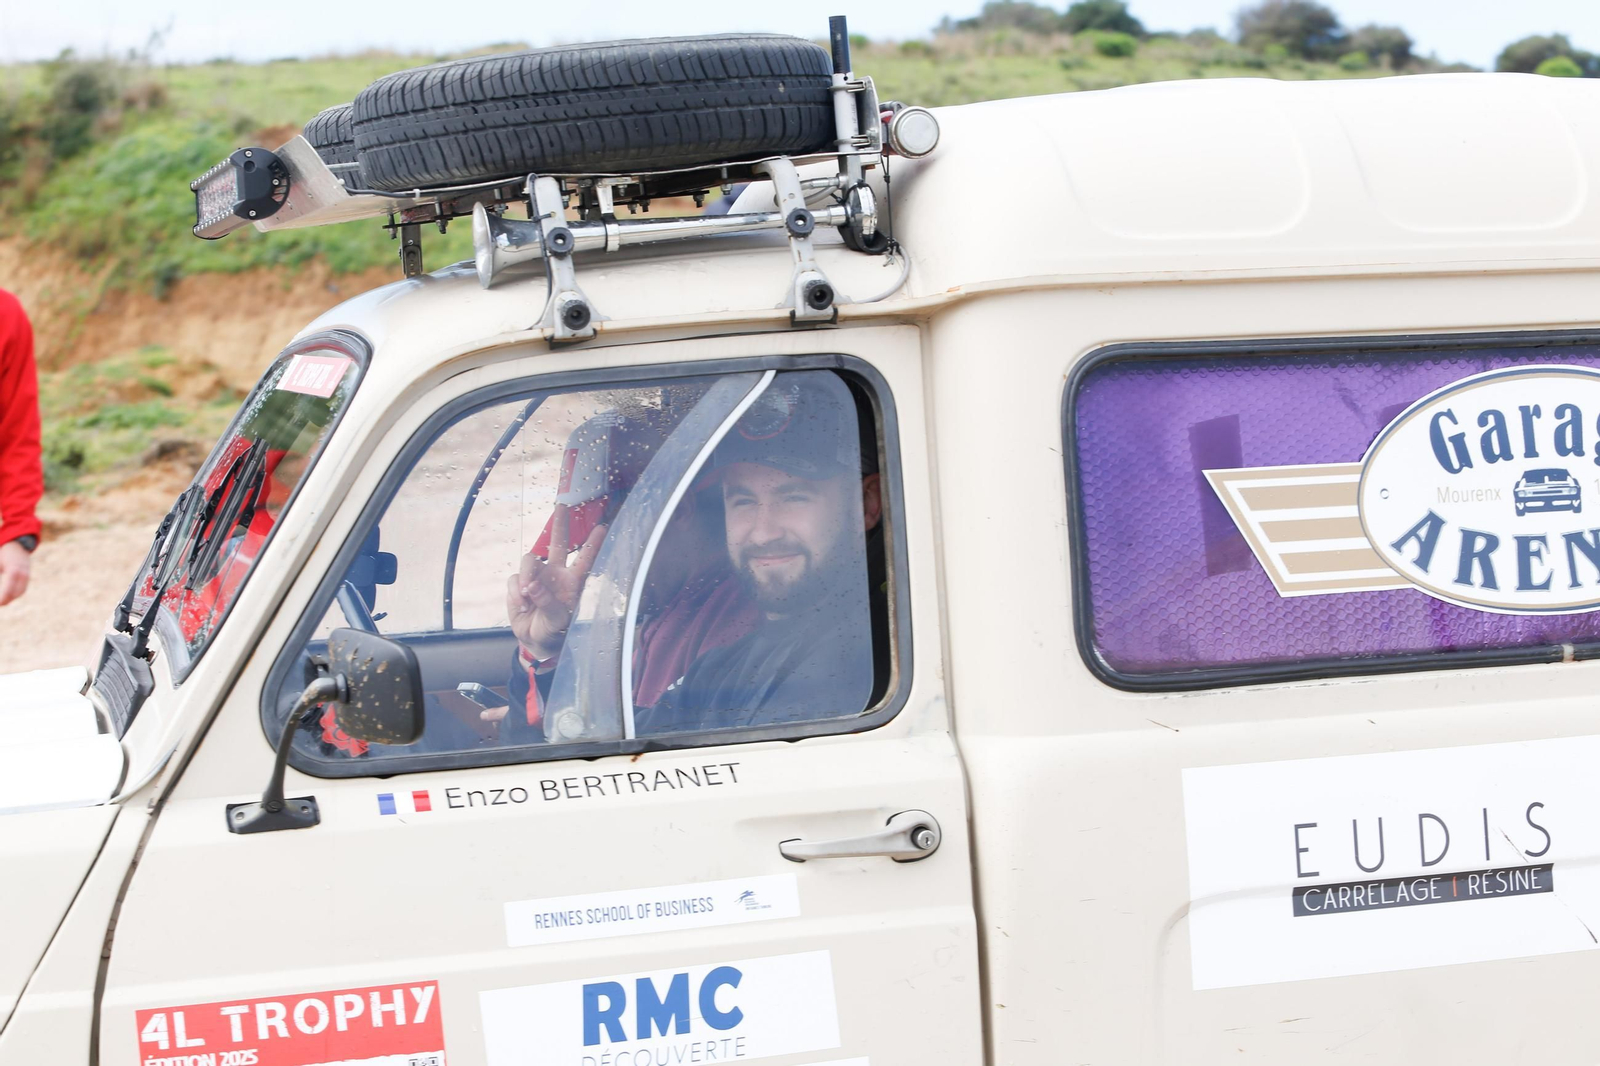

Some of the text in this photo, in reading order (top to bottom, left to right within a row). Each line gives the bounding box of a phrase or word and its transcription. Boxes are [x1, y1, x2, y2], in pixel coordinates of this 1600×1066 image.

[1429, 403, 1600, 475] Gara
[1437, 486, 1502, 504] Mourenx
[445, 762, 740, 809] Enzo BERTRANET
[1294, 802, 1551, 878] EUDIS
[534, 896, 715, 930] RENNES SCHOOL OF BUSINESS
[1302, 868, 1542, 912] CARRELAGE RÉSINE
[141, 985, 436, 1051] 4L TROPHY
[582, 966, 744, 1046] RMC
[219, 1049, 259, 1066] 2025
